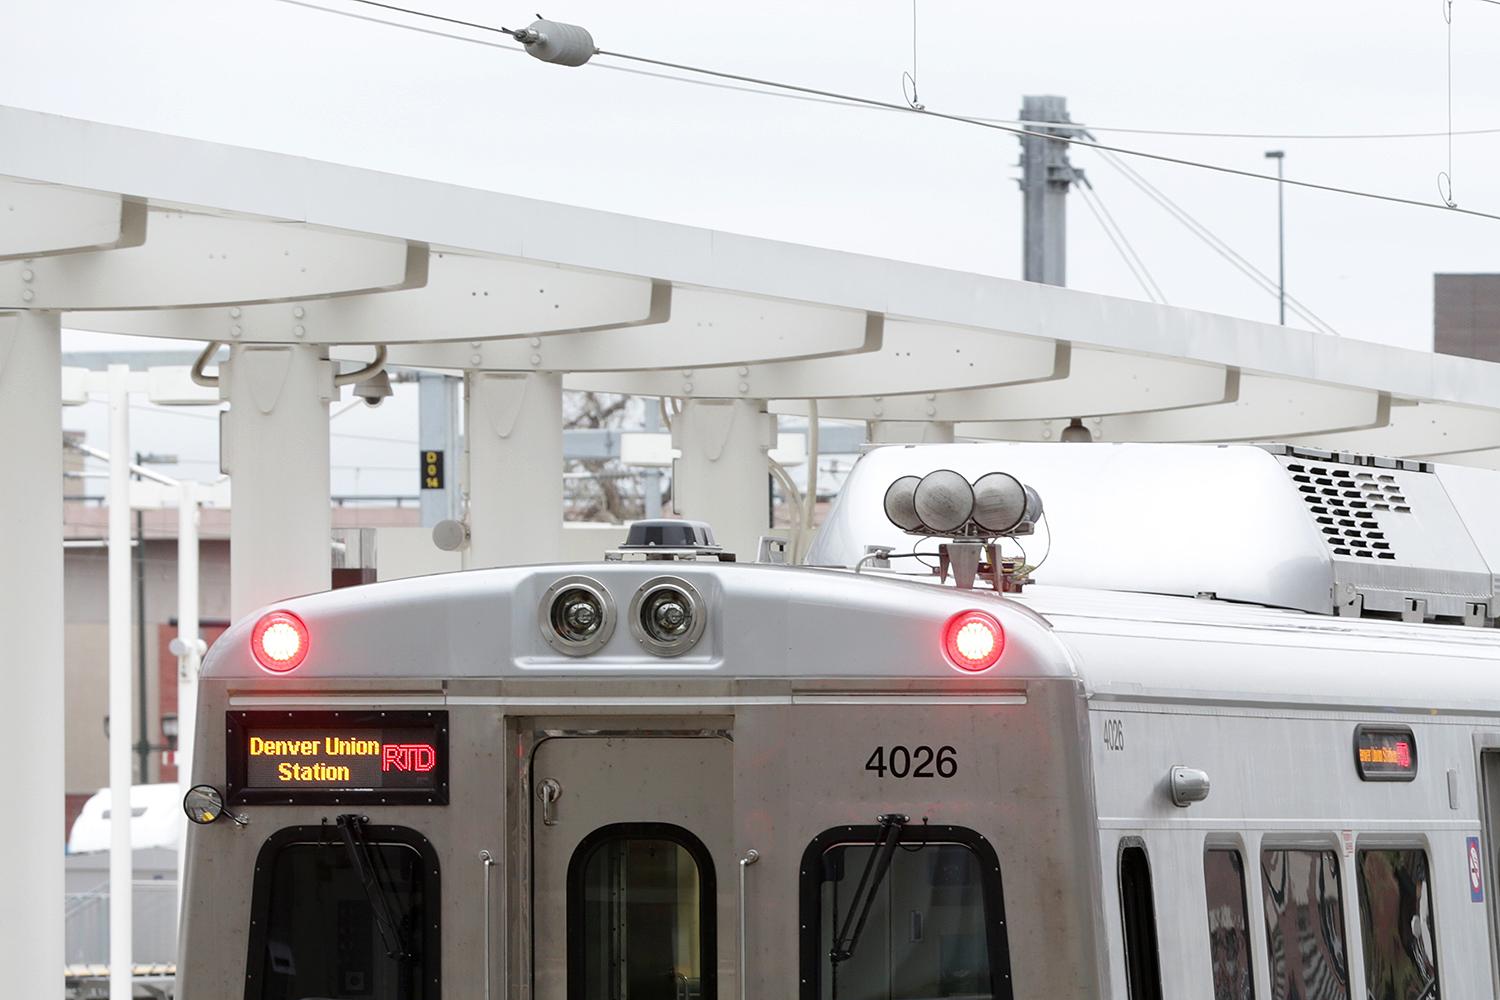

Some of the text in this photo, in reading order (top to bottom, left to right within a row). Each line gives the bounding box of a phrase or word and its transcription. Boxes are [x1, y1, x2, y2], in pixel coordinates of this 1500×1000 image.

[250, 737, 380, 756] Denver Union
[1103, 719, 1124, 751] 4026
[278, 762, 350, 782] Station
[381, 744, 436, 772] RTD
[865, 745, 958, 778] 4026
